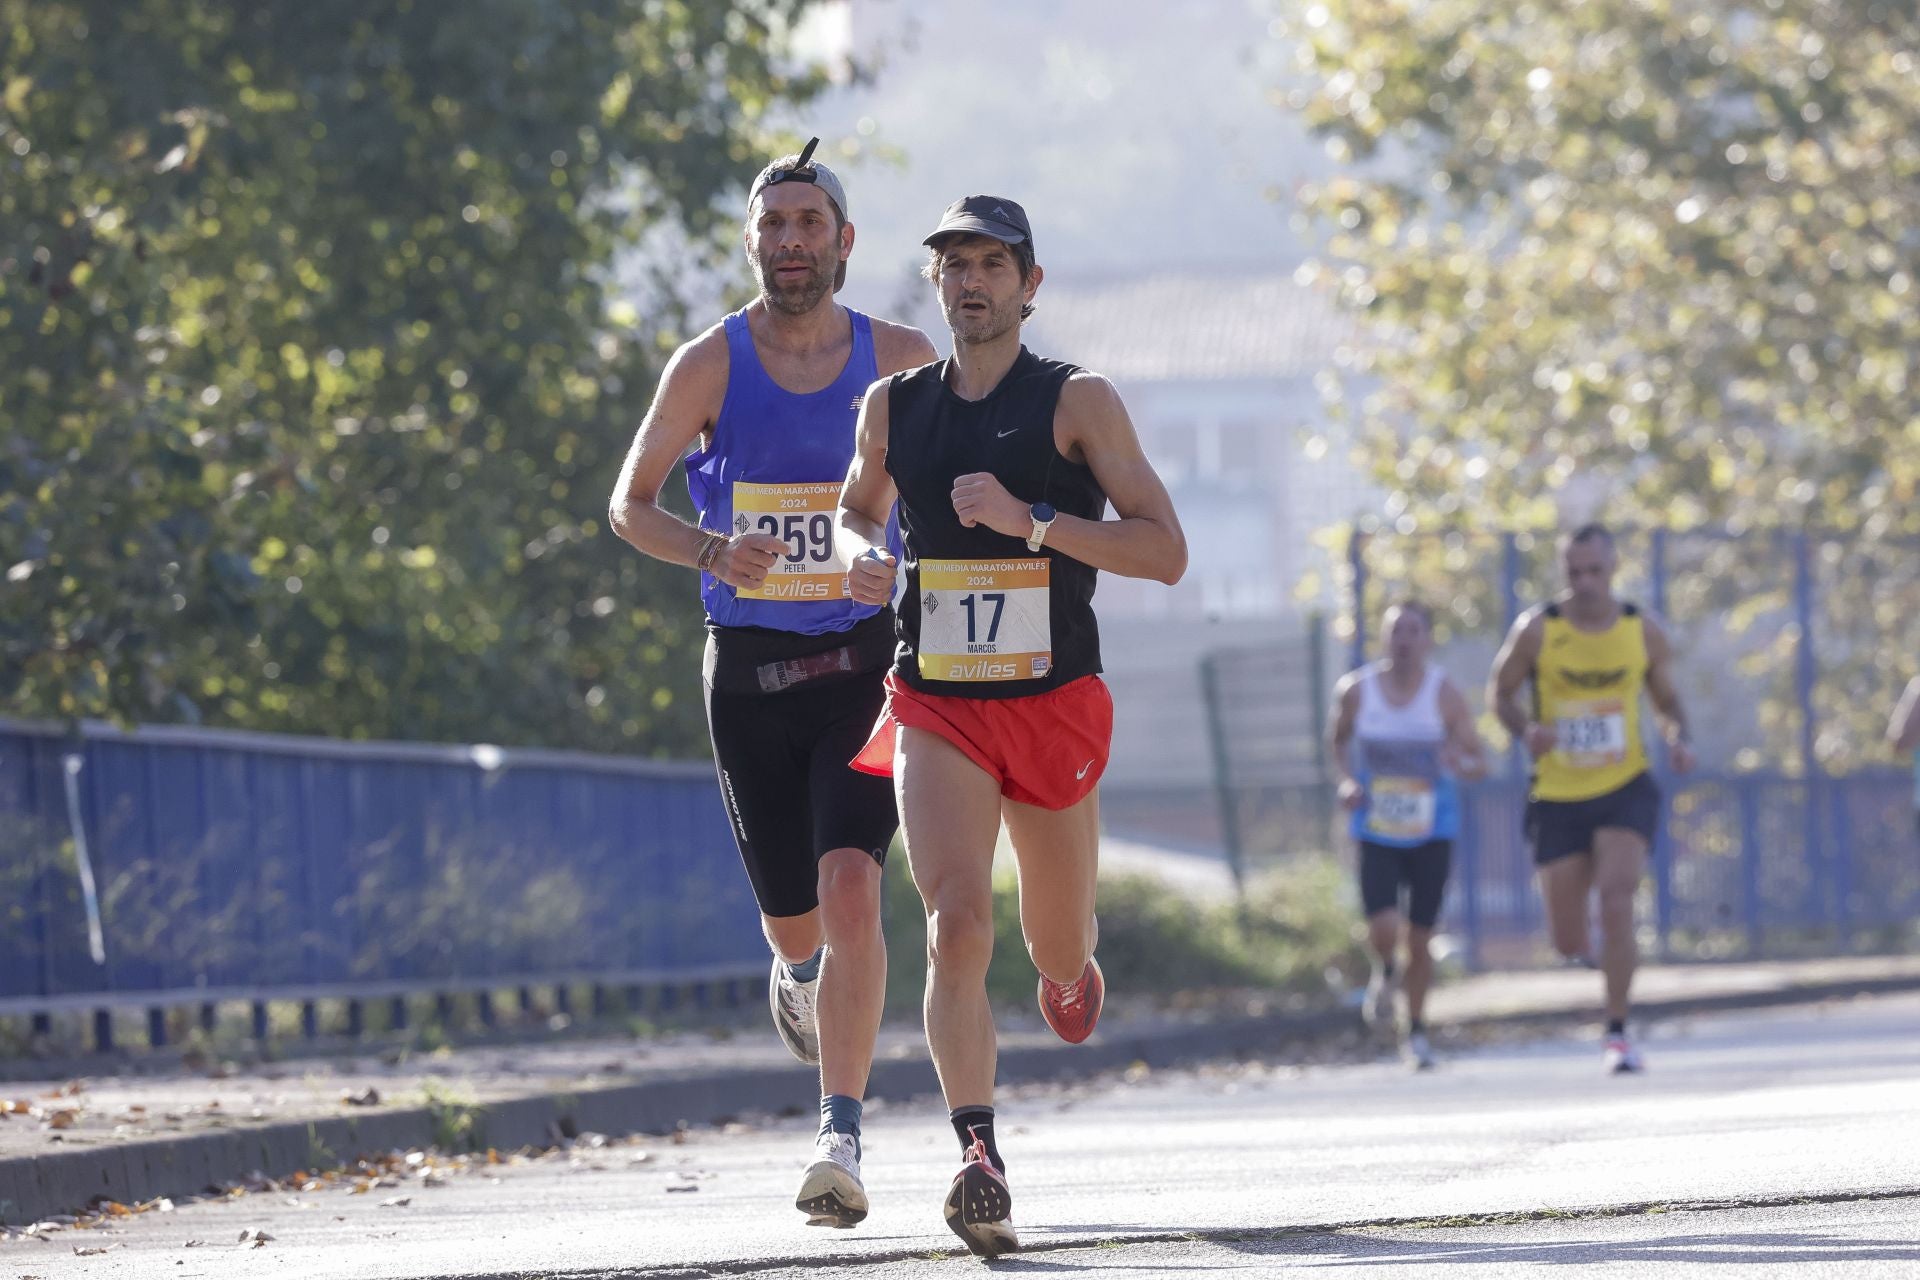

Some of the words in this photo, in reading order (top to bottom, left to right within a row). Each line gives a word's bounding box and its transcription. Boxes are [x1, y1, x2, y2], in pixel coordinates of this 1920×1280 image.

[758, 487, 783, 495] MEDIA
[784, 485, 828, 495] MARATÓN
[780, 499, 808, 509] 2024
[784, 563, 806, 573] PETER
[943, 563, 969, 573] MEDIA
[970, 561, 1014, 572] MARATÓN
[1016, 560, 1046, 571] AVILÉS
[966, 576, 994, 586] 2024
[763, 580, 830, 597] avilés
[959, 593, 1005, 643] 17
[967, 644, 997, 654] MARCOS
[949, 660, 1017, 679] avilés
[722, 769, 748, 842] SALOMON
